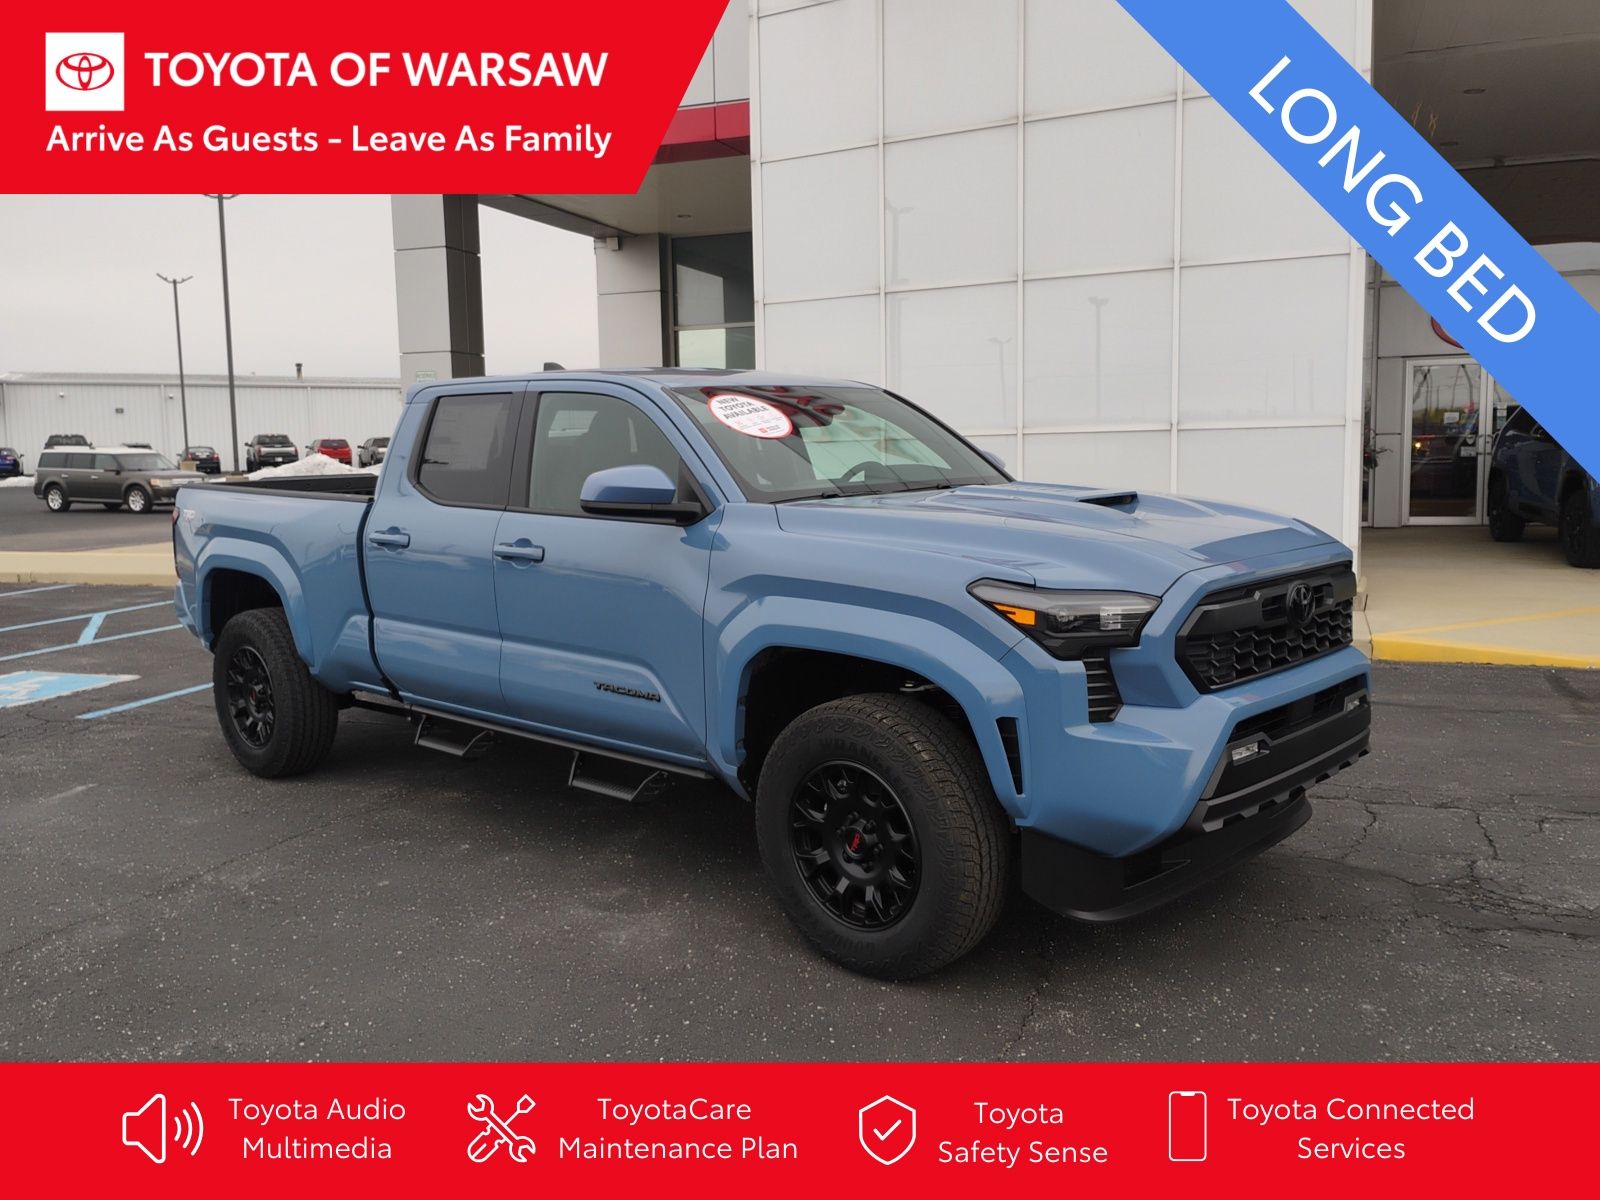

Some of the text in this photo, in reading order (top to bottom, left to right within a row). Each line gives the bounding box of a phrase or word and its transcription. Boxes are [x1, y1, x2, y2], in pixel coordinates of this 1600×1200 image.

[719, 401, 752, 412] TOYOTA
[723, 406, 768, 419] AVAILABLE
[593, 681, 661, 702] TACOMA
